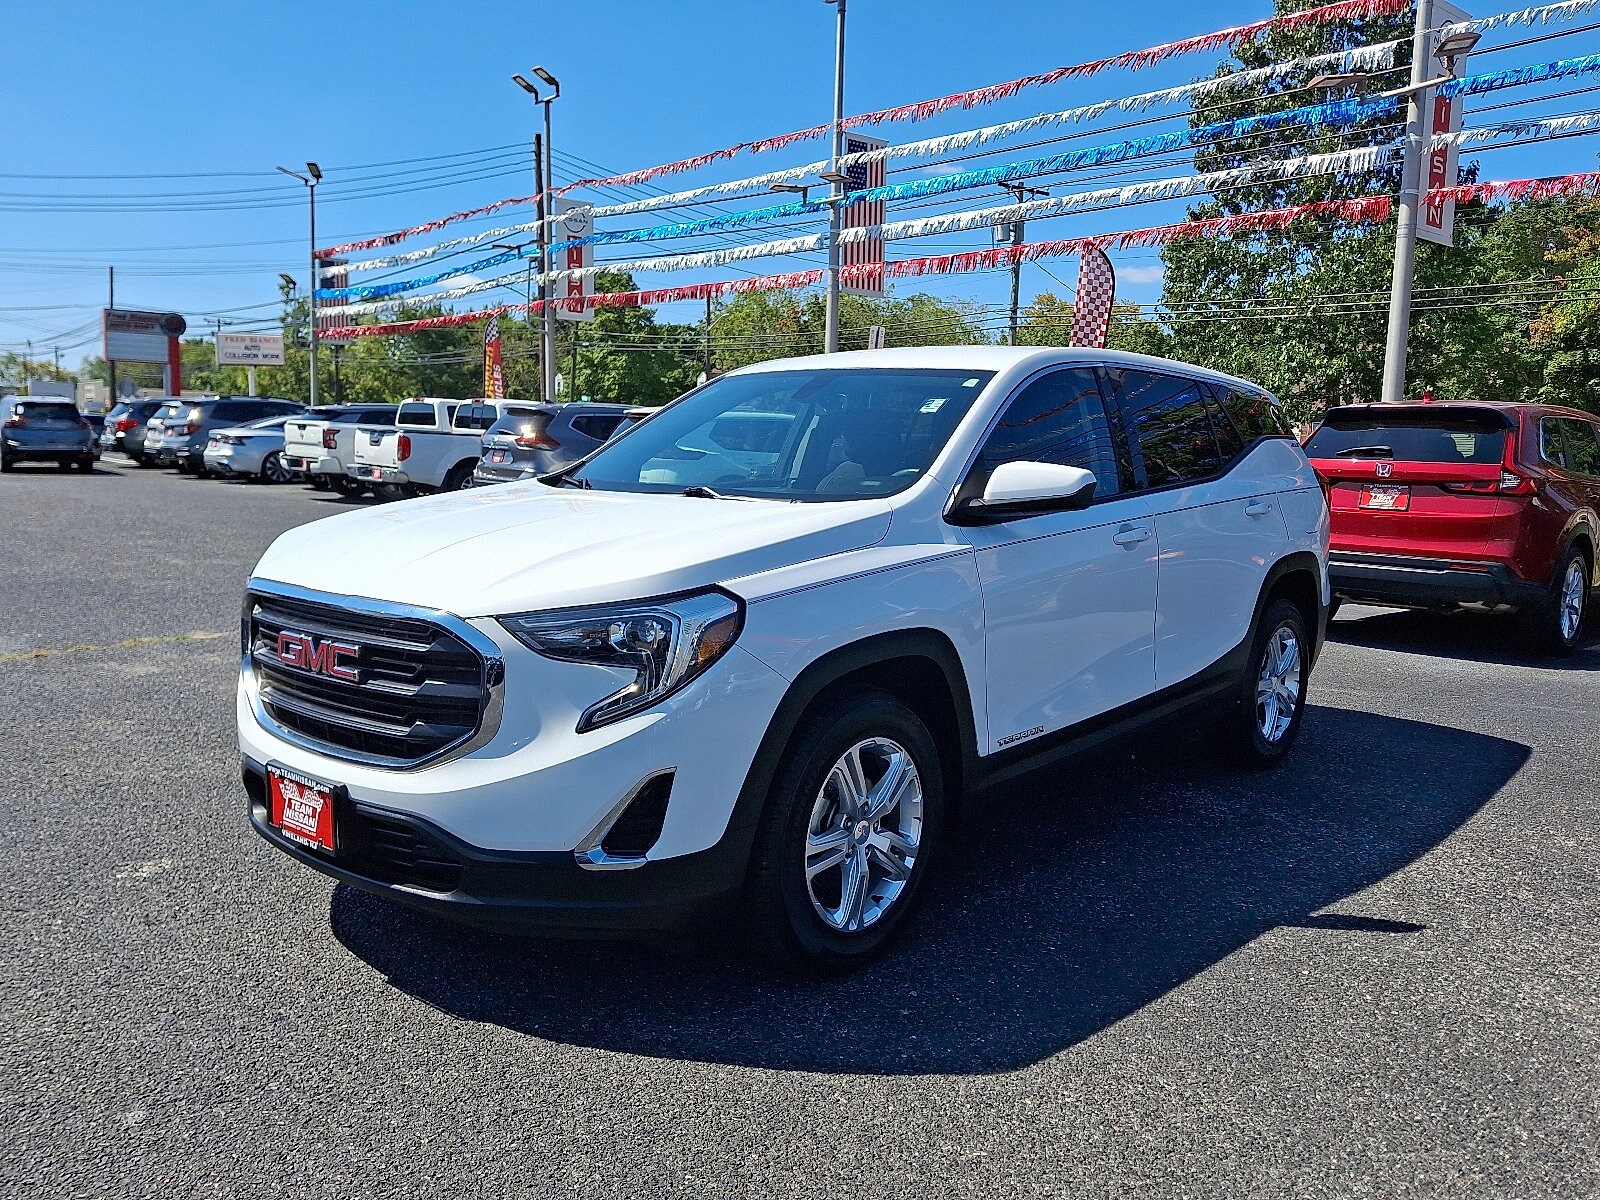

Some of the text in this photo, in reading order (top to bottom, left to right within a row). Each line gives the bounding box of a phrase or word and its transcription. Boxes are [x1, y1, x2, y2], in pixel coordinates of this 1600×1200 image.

[278, 630, 360, 682] GMC
[286, 808, 315, 827] NISSAN
[291, 800, 313, 817] TEAM
